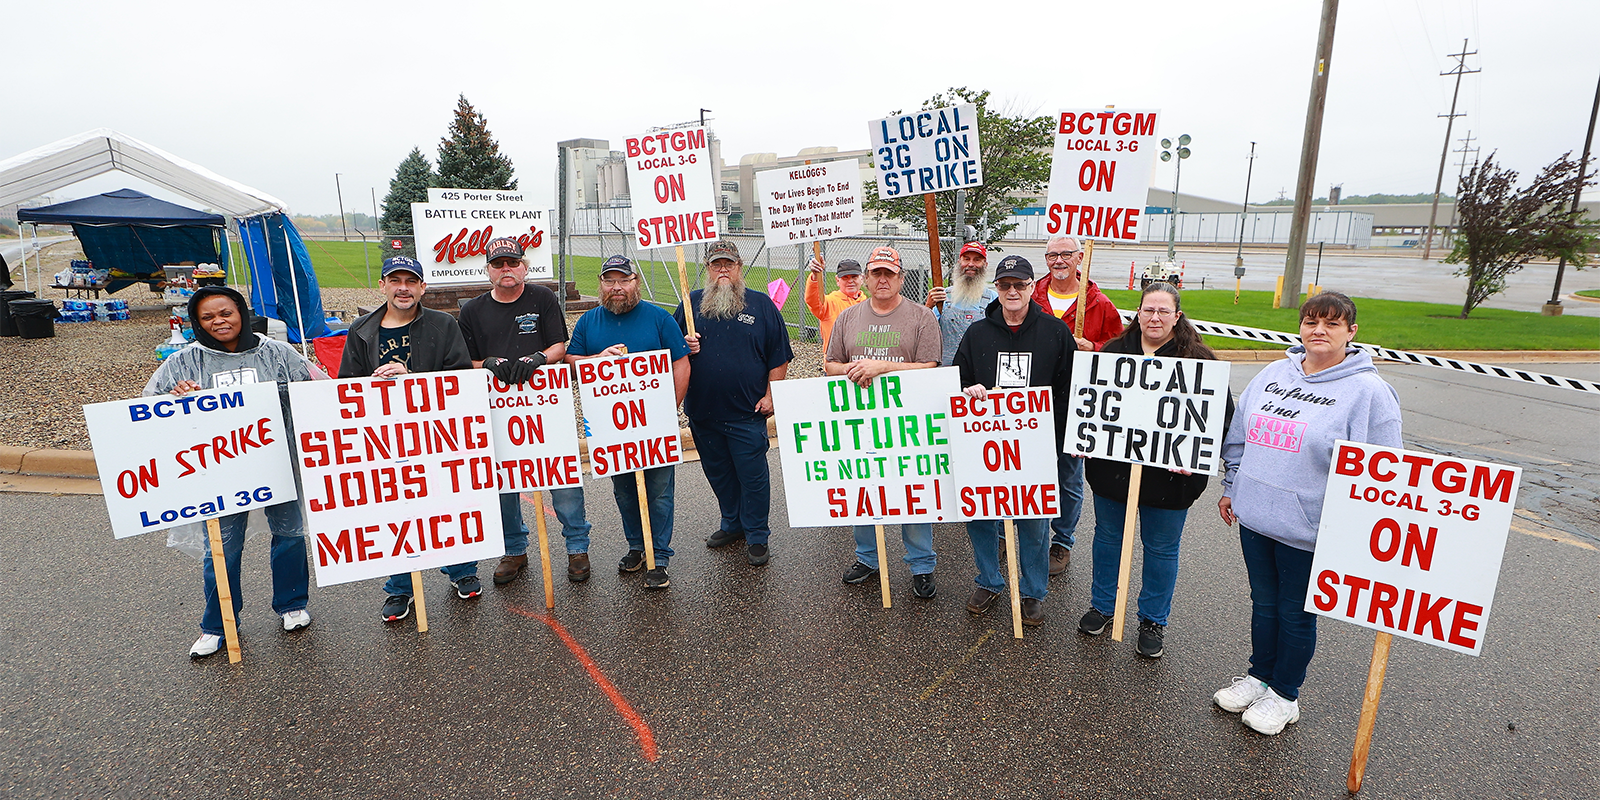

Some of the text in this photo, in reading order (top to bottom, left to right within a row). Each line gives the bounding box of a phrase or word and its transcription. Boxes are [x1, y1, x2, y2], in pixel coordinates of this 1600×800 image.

[881, 107, 969, 144] LOCAL
[1059, 112, 1156, 136] BCTGM
[626, 129, 706, 158] BCTGM
[878, 134, 969, 171] 3G ON
[1067, 139, 1138, 152] LOCAL 3-G
[638, 154, 696, 171] LOCAL 3-G
[790, 167, 826, 180] KELLOGG'S
[884, 159, 978, 196] STRIKE
[1079, 159, 1116, 192] ON
[441, 192, 523, 202] 425 Porter Street
[654, 173, 685, 204] ON
[771, 182, 849, 200] "Our Lives Begin To End
[425, 209, 542, 219] BATTLE CREEK PLANT
[768, 207, 780, 215] The
[783, 204, 794, 214] Day
[808, 200, 833, 209] Become
[836, 196, 854, 205] Silent
[771, 210, 854, 229] About Things That Matter"
[1047, 203, 1140, 240] STRIKE
[638, 210, 716, 246] STRIKE
[789, 232, 798, 240] Dr.
[800, 230, 808, 238] M.
[810, 229, 815, 237] L.
[817, 227, 832, 236] King
[433, 225, 544, 264] Kellg's
[856, 332, 901, 347] ARGUING
[864, 347, 889, 356] I'M JUST
[487, 368, 569, 393] CGM
[579, 354, 669, 384] BCTGM
[1090, 354, 1214, 395] LOCAL
[338, 376, 460, 419] STOP
[489, 394, 558, 409] LOCAL 3-G
[593, 379, 660, 397] LOCAL 3-G
[828, 376, 903, 412] OUR
[950, 390, 1051, 418] BCTGM
[1265, 382, 1336, 406] Our future
[129, 391, 245, 423] BCTGM
[612, 399, 647, 430] ON
[1076, 388, 1209, 433] 3G ON
[1261, 401, 1300, 418] is not
[508, 414, 544, 446] ON
[793, 413, 948, 453] FUTURE
[964, 418, 1038, 433] LOCAL 3-G
[1249, 428, 1298, 449] SALE
[1255, 417, 1297, 435] FOR
[300, 416, 488, 468] SENDING
[593, 435, 679, 475] STRIKE
[983, 440, 1021, 472] ON
[1076, 422, 1213, 471] STRIKE
[117, 418, 275, 499] ON STRIKE
[805, 453, 950, 481] IS NOT FOR
[1335, 445, 1515, 503] BCTGM
[310, 456, 493, 512] JOBS TO
[140, 486, 273, 528] Local 3G
[827, 479, 943, 522] SALE!
[960, 484, 1058, 517] STRIKE
[1350, 484, 1480, 521] LOCAL 3-G
[317, 511, 484, 567] MEXICO
[1369, 518, 1438, 571] ON
[1313, 570, 1484, 649] STRIKE
